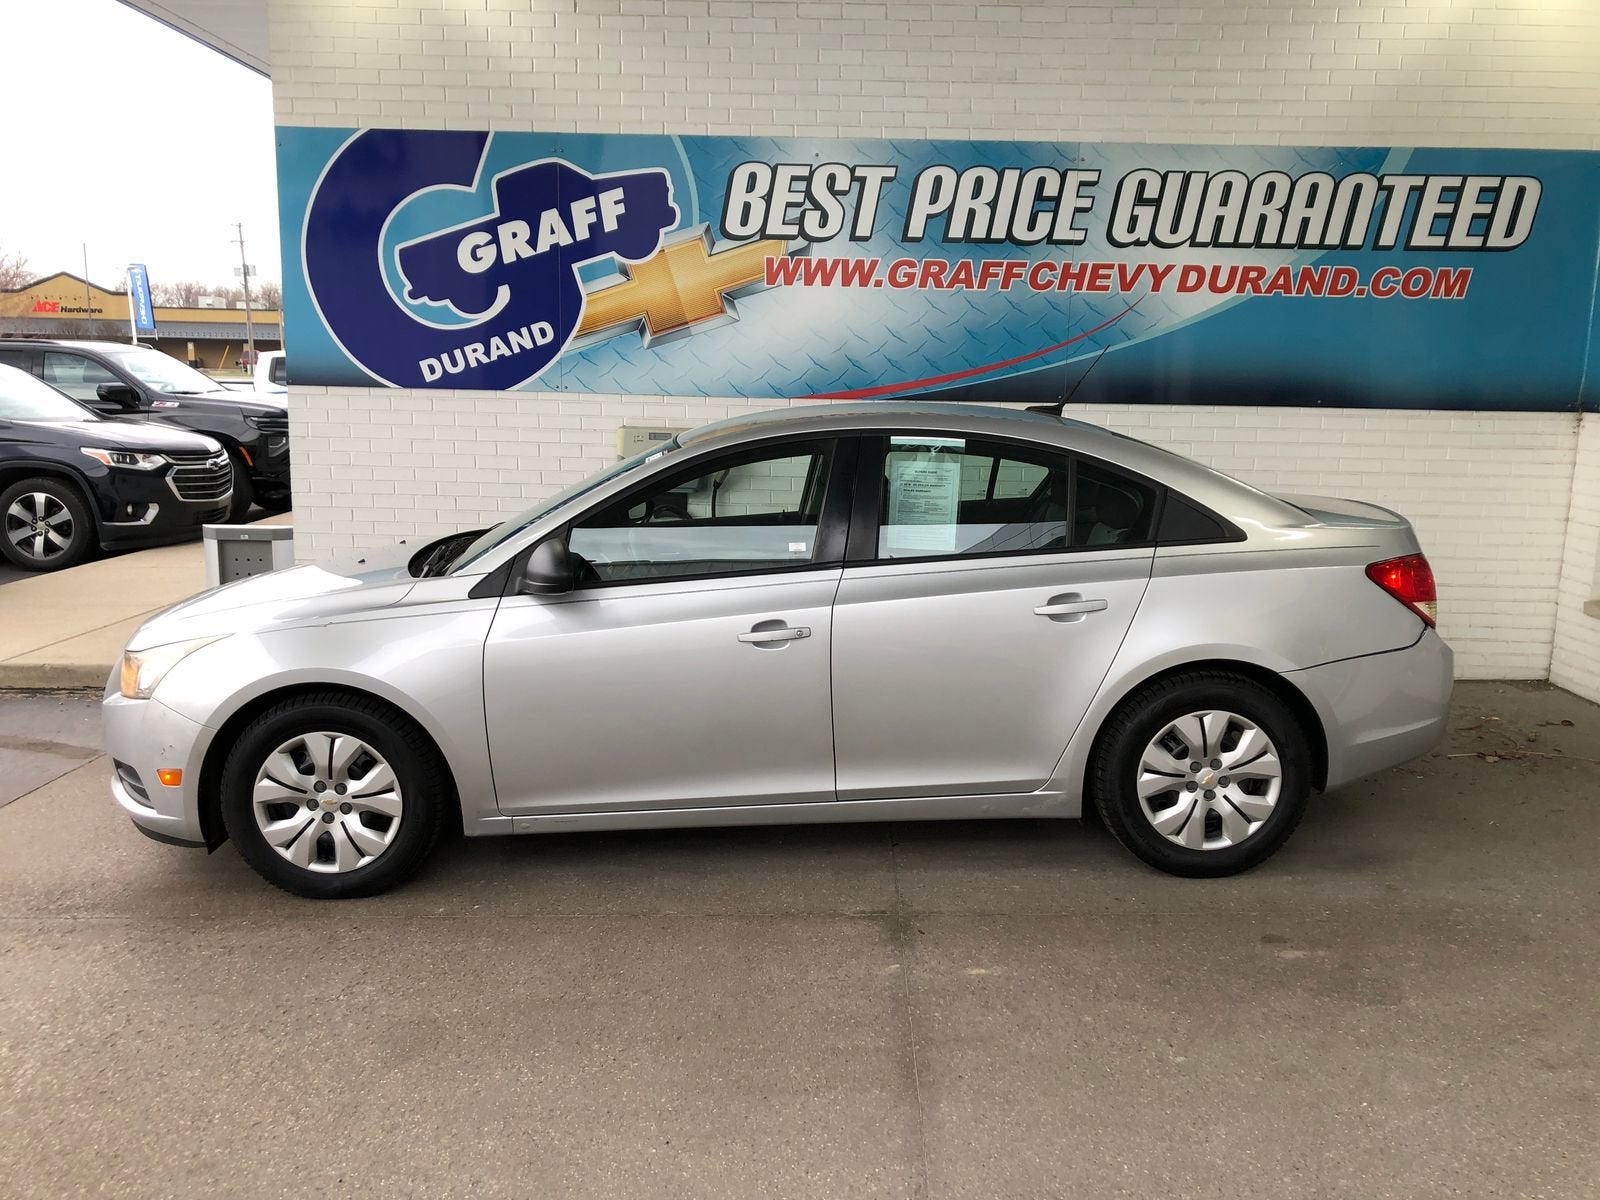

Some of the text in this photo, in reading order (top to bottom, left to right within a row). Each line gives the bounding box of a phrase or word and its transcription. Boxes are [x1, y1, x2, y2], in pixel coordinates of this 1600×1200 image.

[457, 186, 626, 274] GRAFF
[719, 161, 1543, 252] BEST PRICE GUARANTEED
[32, 300, 103, 314] ACE Hardware
[764, 255, 1474, 300] WWW.GRAFFCHEVYDURAND.COM
[418, 320, 554, 383] DURAND
